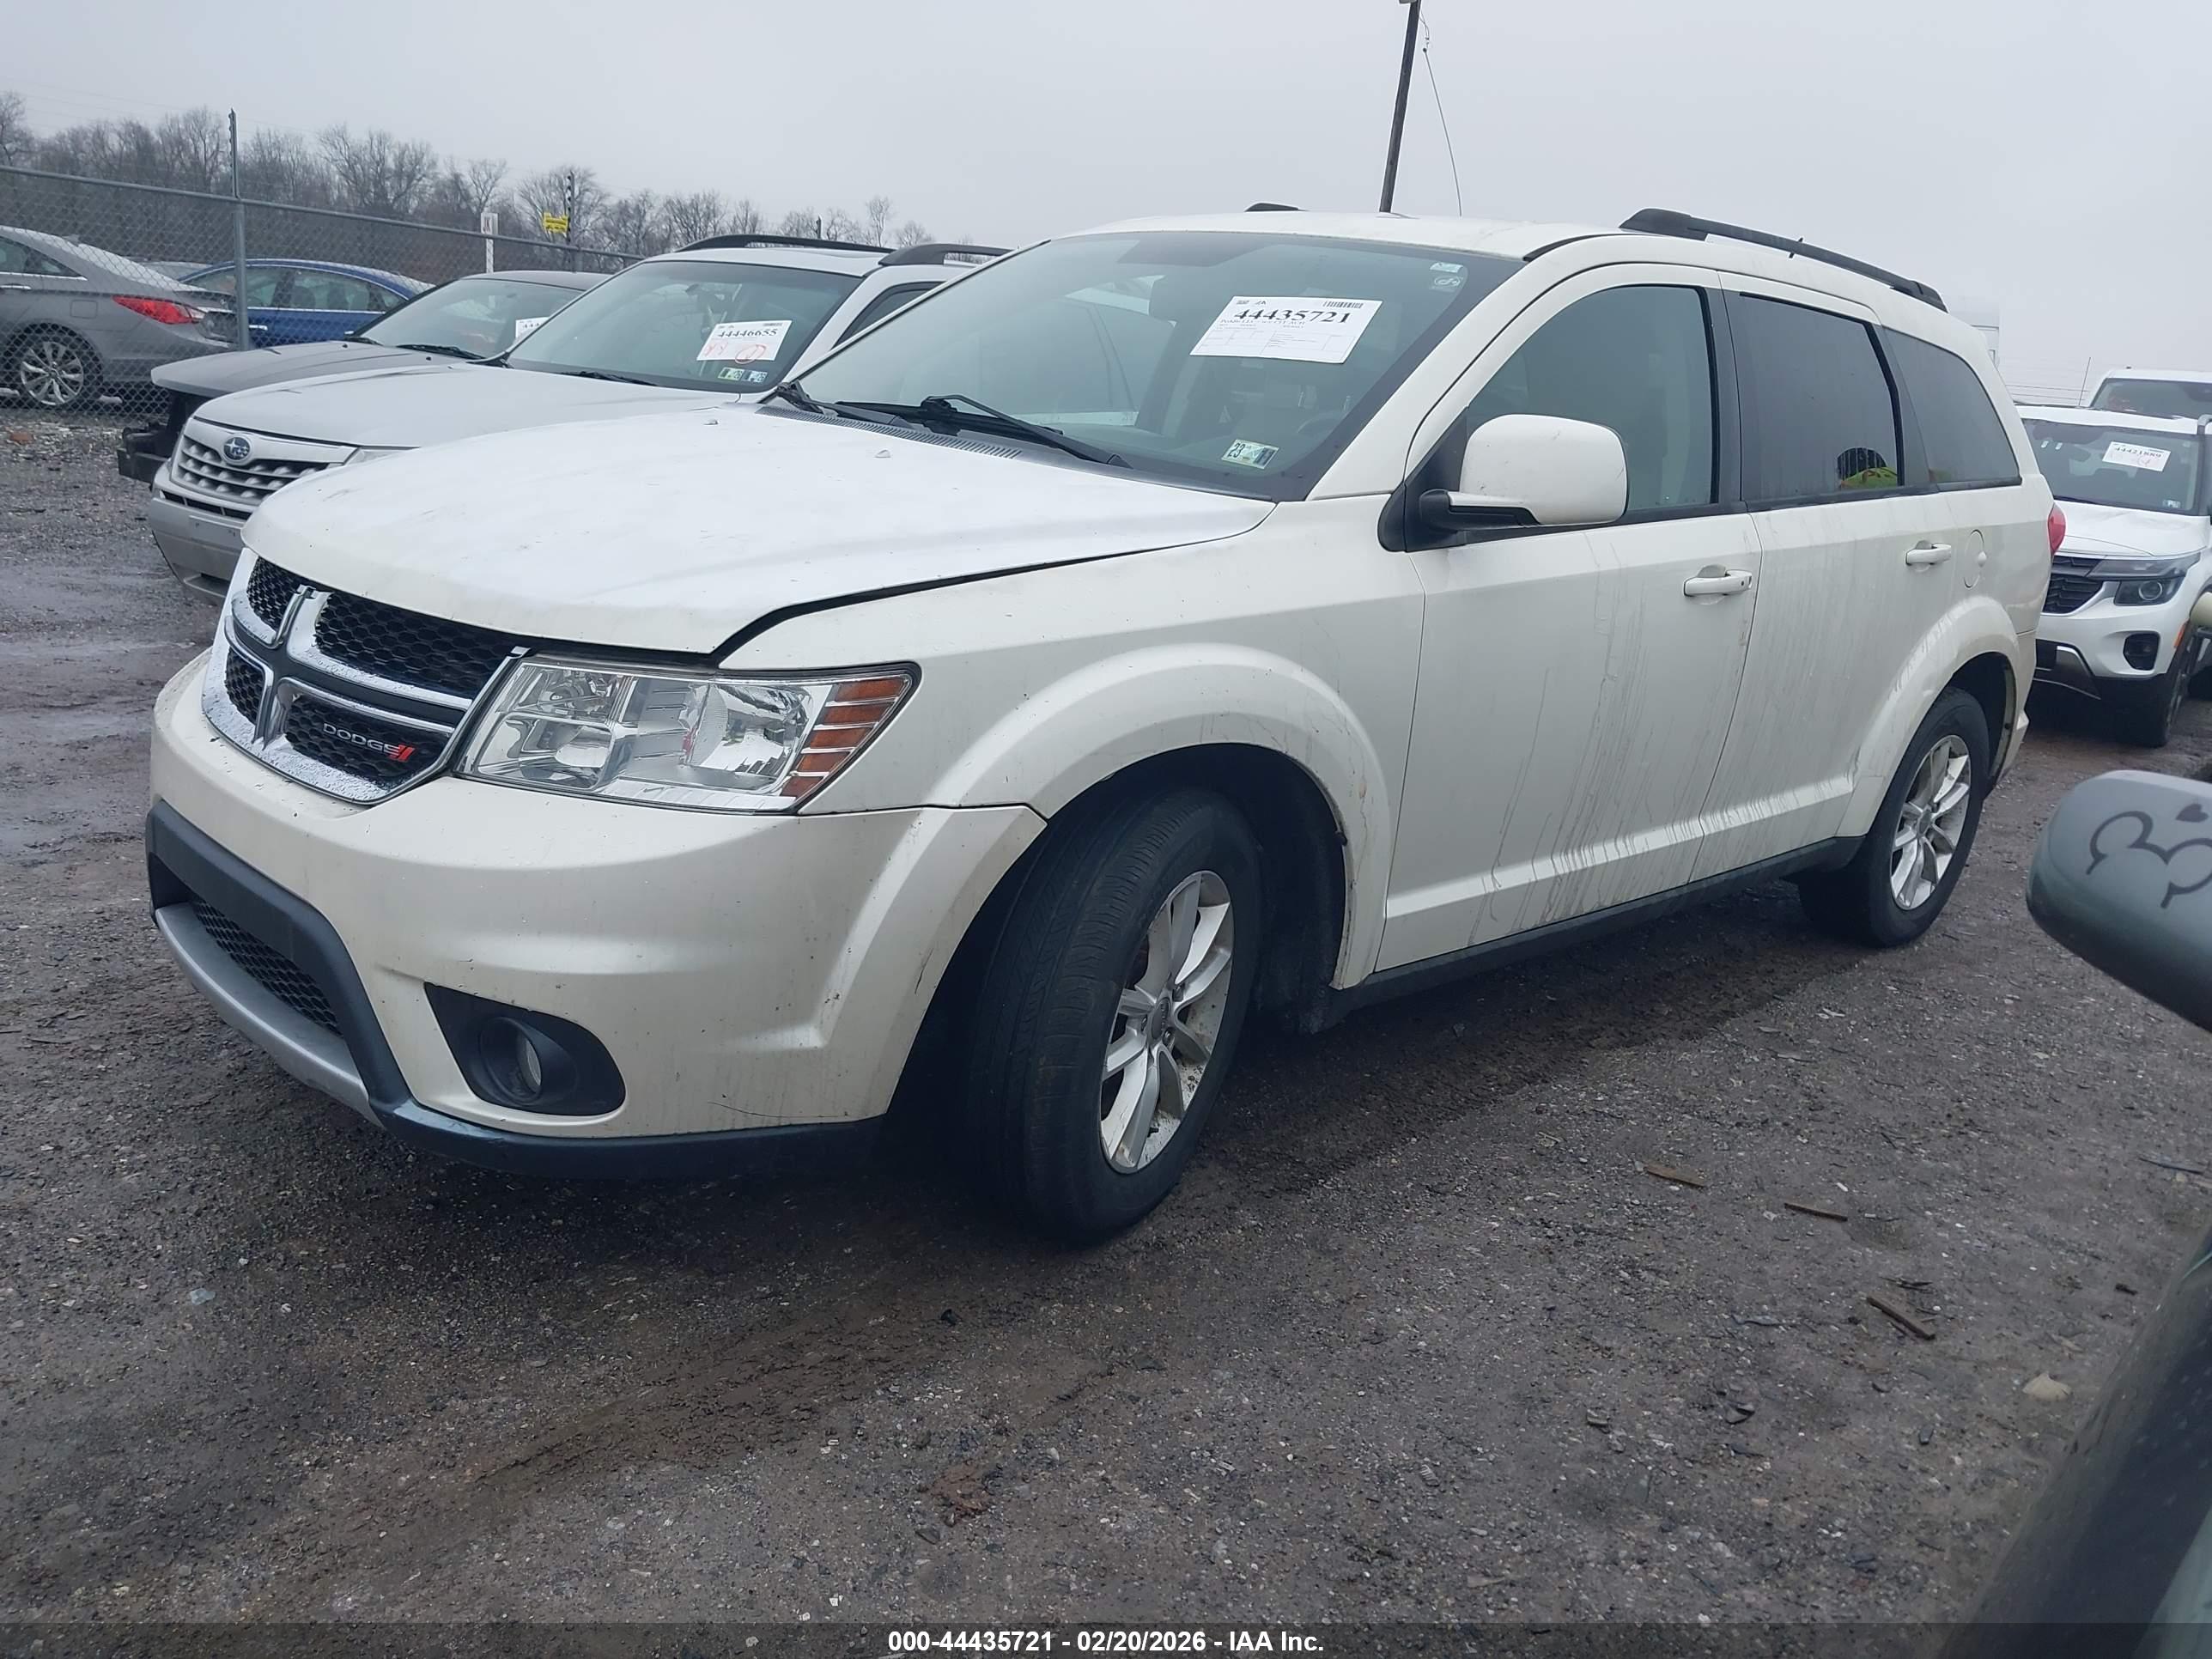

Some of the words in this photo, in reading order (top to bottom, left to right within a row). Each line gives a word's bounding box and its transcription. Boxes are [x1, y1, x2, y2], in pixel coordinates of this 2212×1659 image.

[1234, 308, 1352, 323] 44435721
[1228, 442, 1246, 459] 23
[323, 722, 400, 757] DODGE
